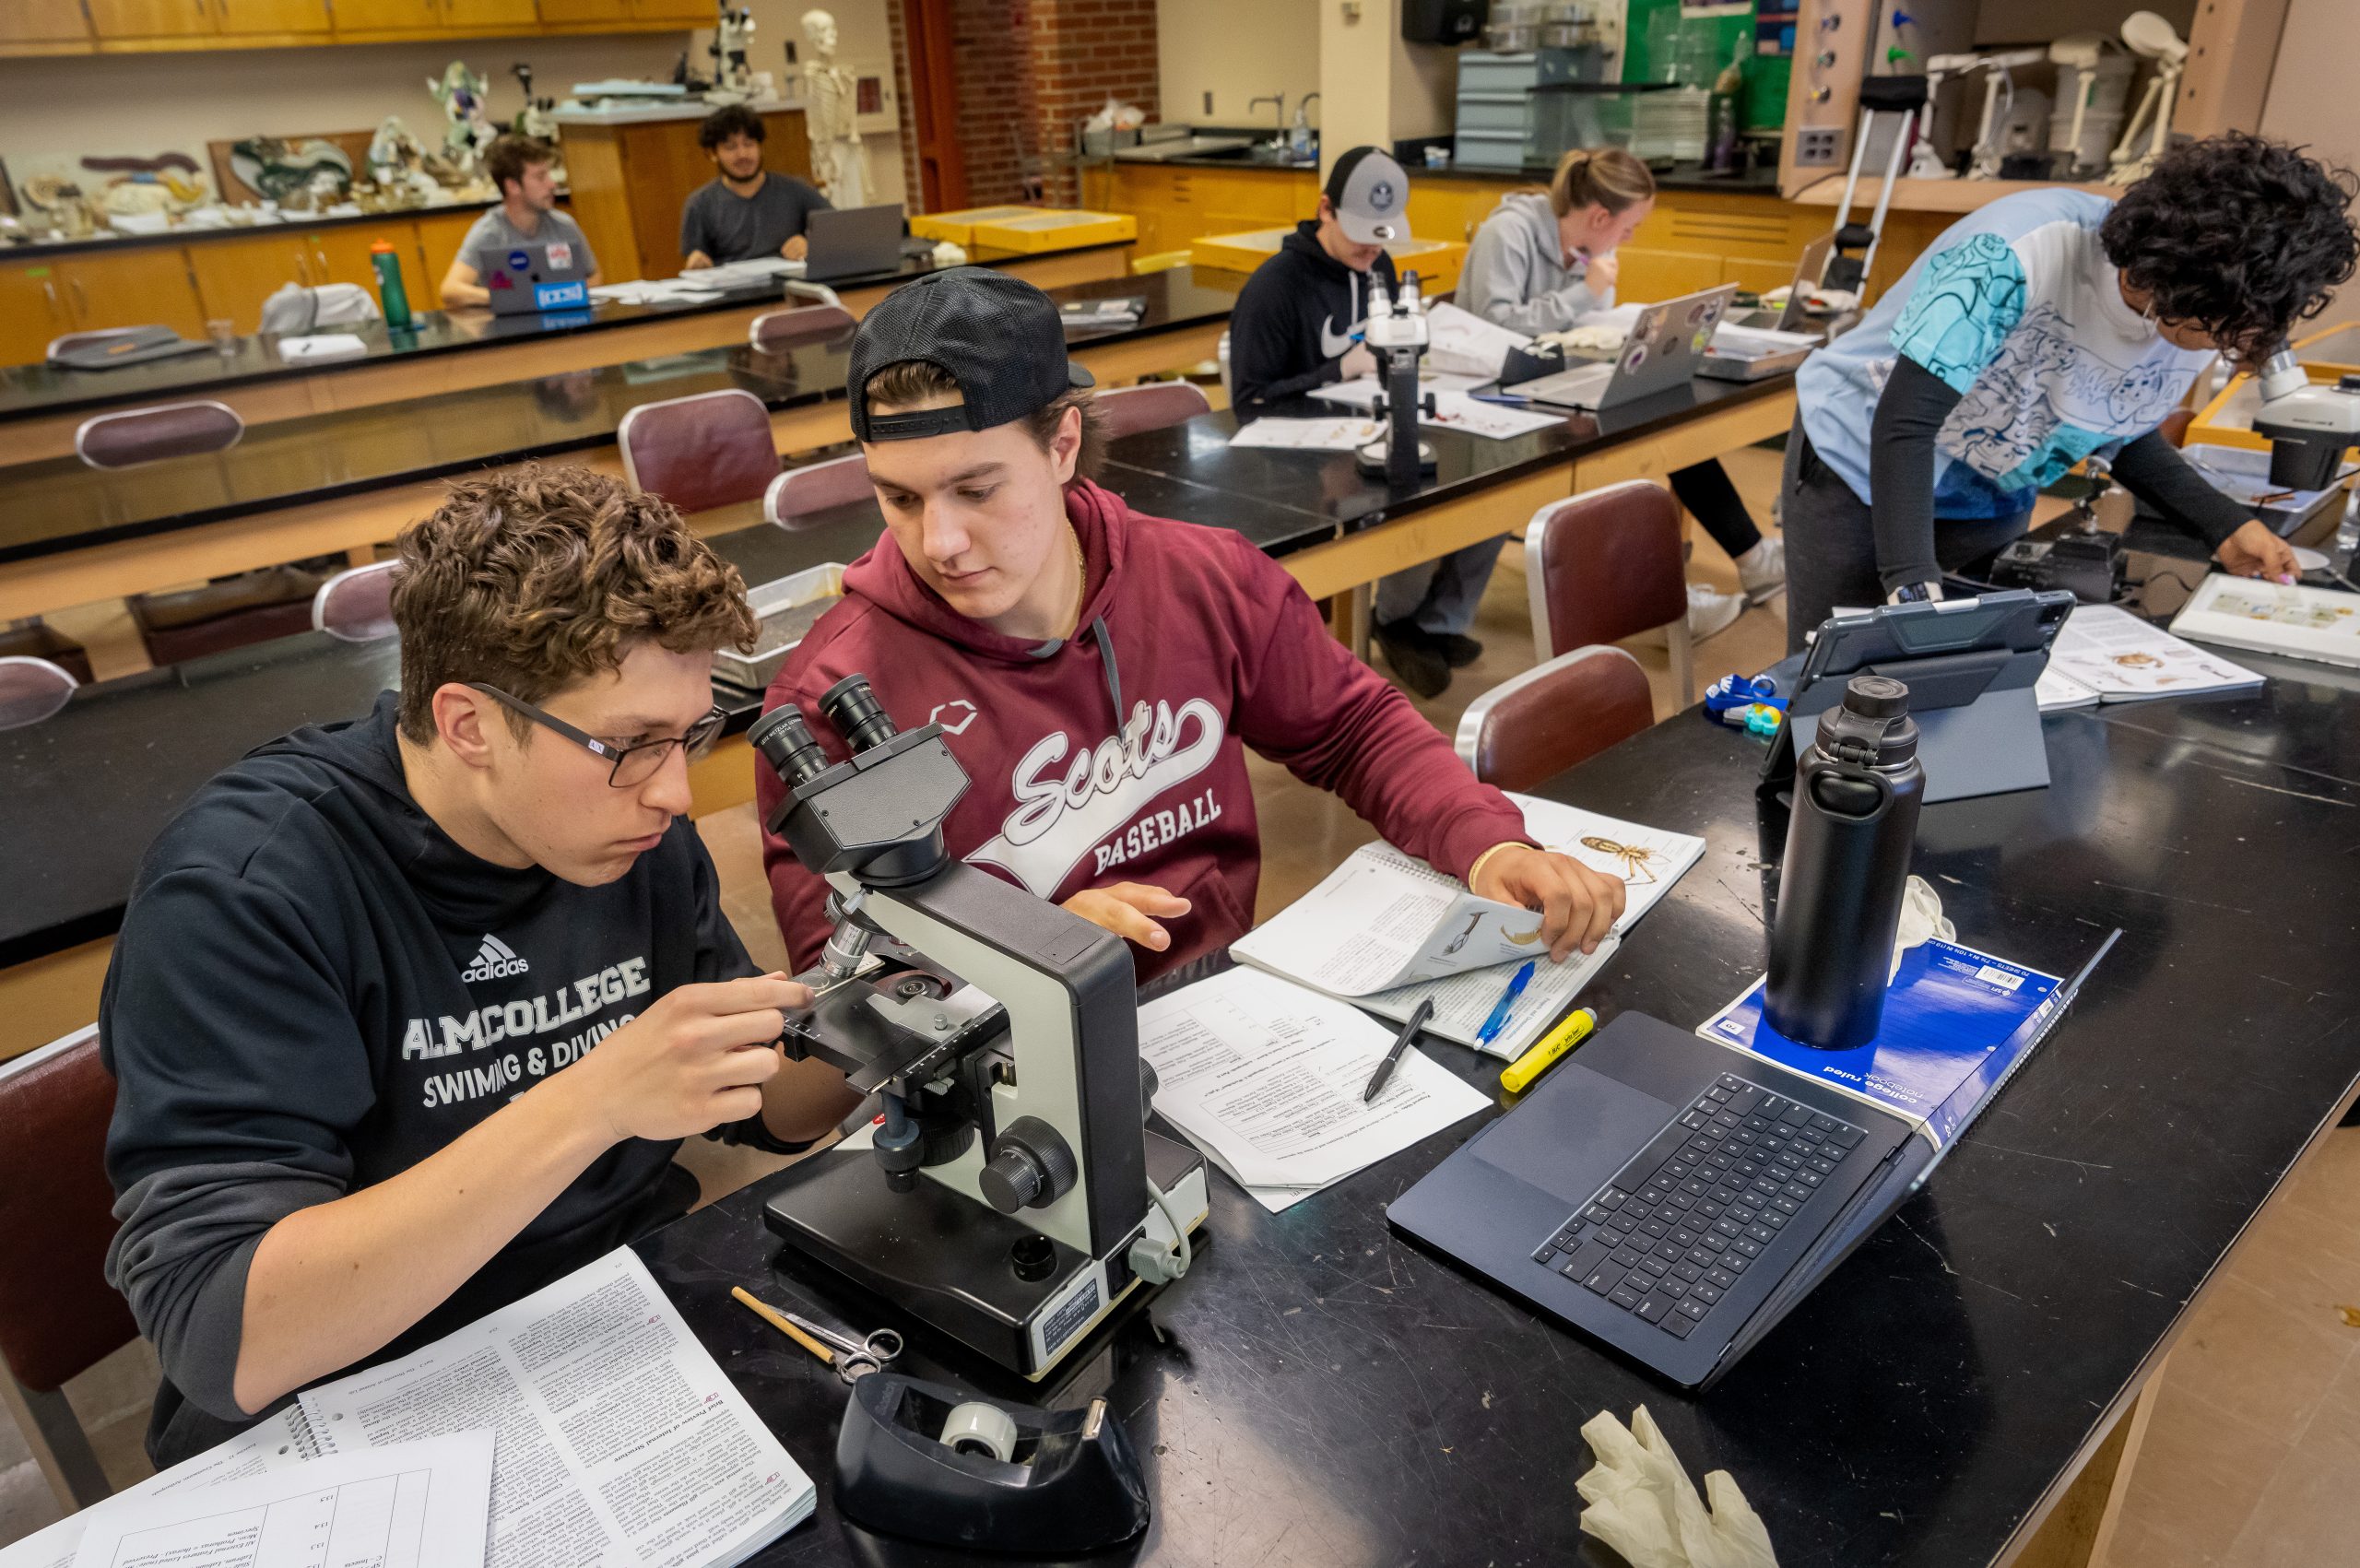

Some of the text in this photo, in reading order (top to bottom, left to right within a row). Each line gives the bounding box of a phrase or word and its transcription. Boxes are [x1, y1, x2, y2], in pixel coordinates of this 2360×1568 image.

[769, 723, 788, 737] WETZLAR
[1002, 699, 1174, 846] Scots
[1094, 788, 1221, 877] BASEBALL
[461, 957, 529, 984] adidas
[1996, 962, 2021, 973] SHEETS
[527, 1047, 547, 1077] &
[1823, 1066, 1917, 1103] college ruled
[1864, 1072, 1925, 1100] notebook
[384, 1372, 405, 1382] Diversity
[359, 1383, 376, 1391] Animal
[707, 1399, 723, 1410] Brief
[681, 1409, 706, 1424] Preview
[645, 1429, 671, 1445] Internal
[236, 1442, 256, 1454] Exercise
[614, 1444, 644, 1462] Structure
[183, 1466, 212, 1480] Crustacean
[151, 1480, 181, 1495] Arthropods
[319, 1494, 333, 1503] 13.5
[507, 1483, 562, 1514] Circulatory System.
[567, 1506, 590, 1521] extensor
[227, 1526, 259, 1537] Specimen
[314, 1521, 327, 1529] 13.4
[310, 1541, 324, 1550] 13.3
[124, 1554, 158, 1565] Preserved
[344, 1558, 368, 1567] Insecta
